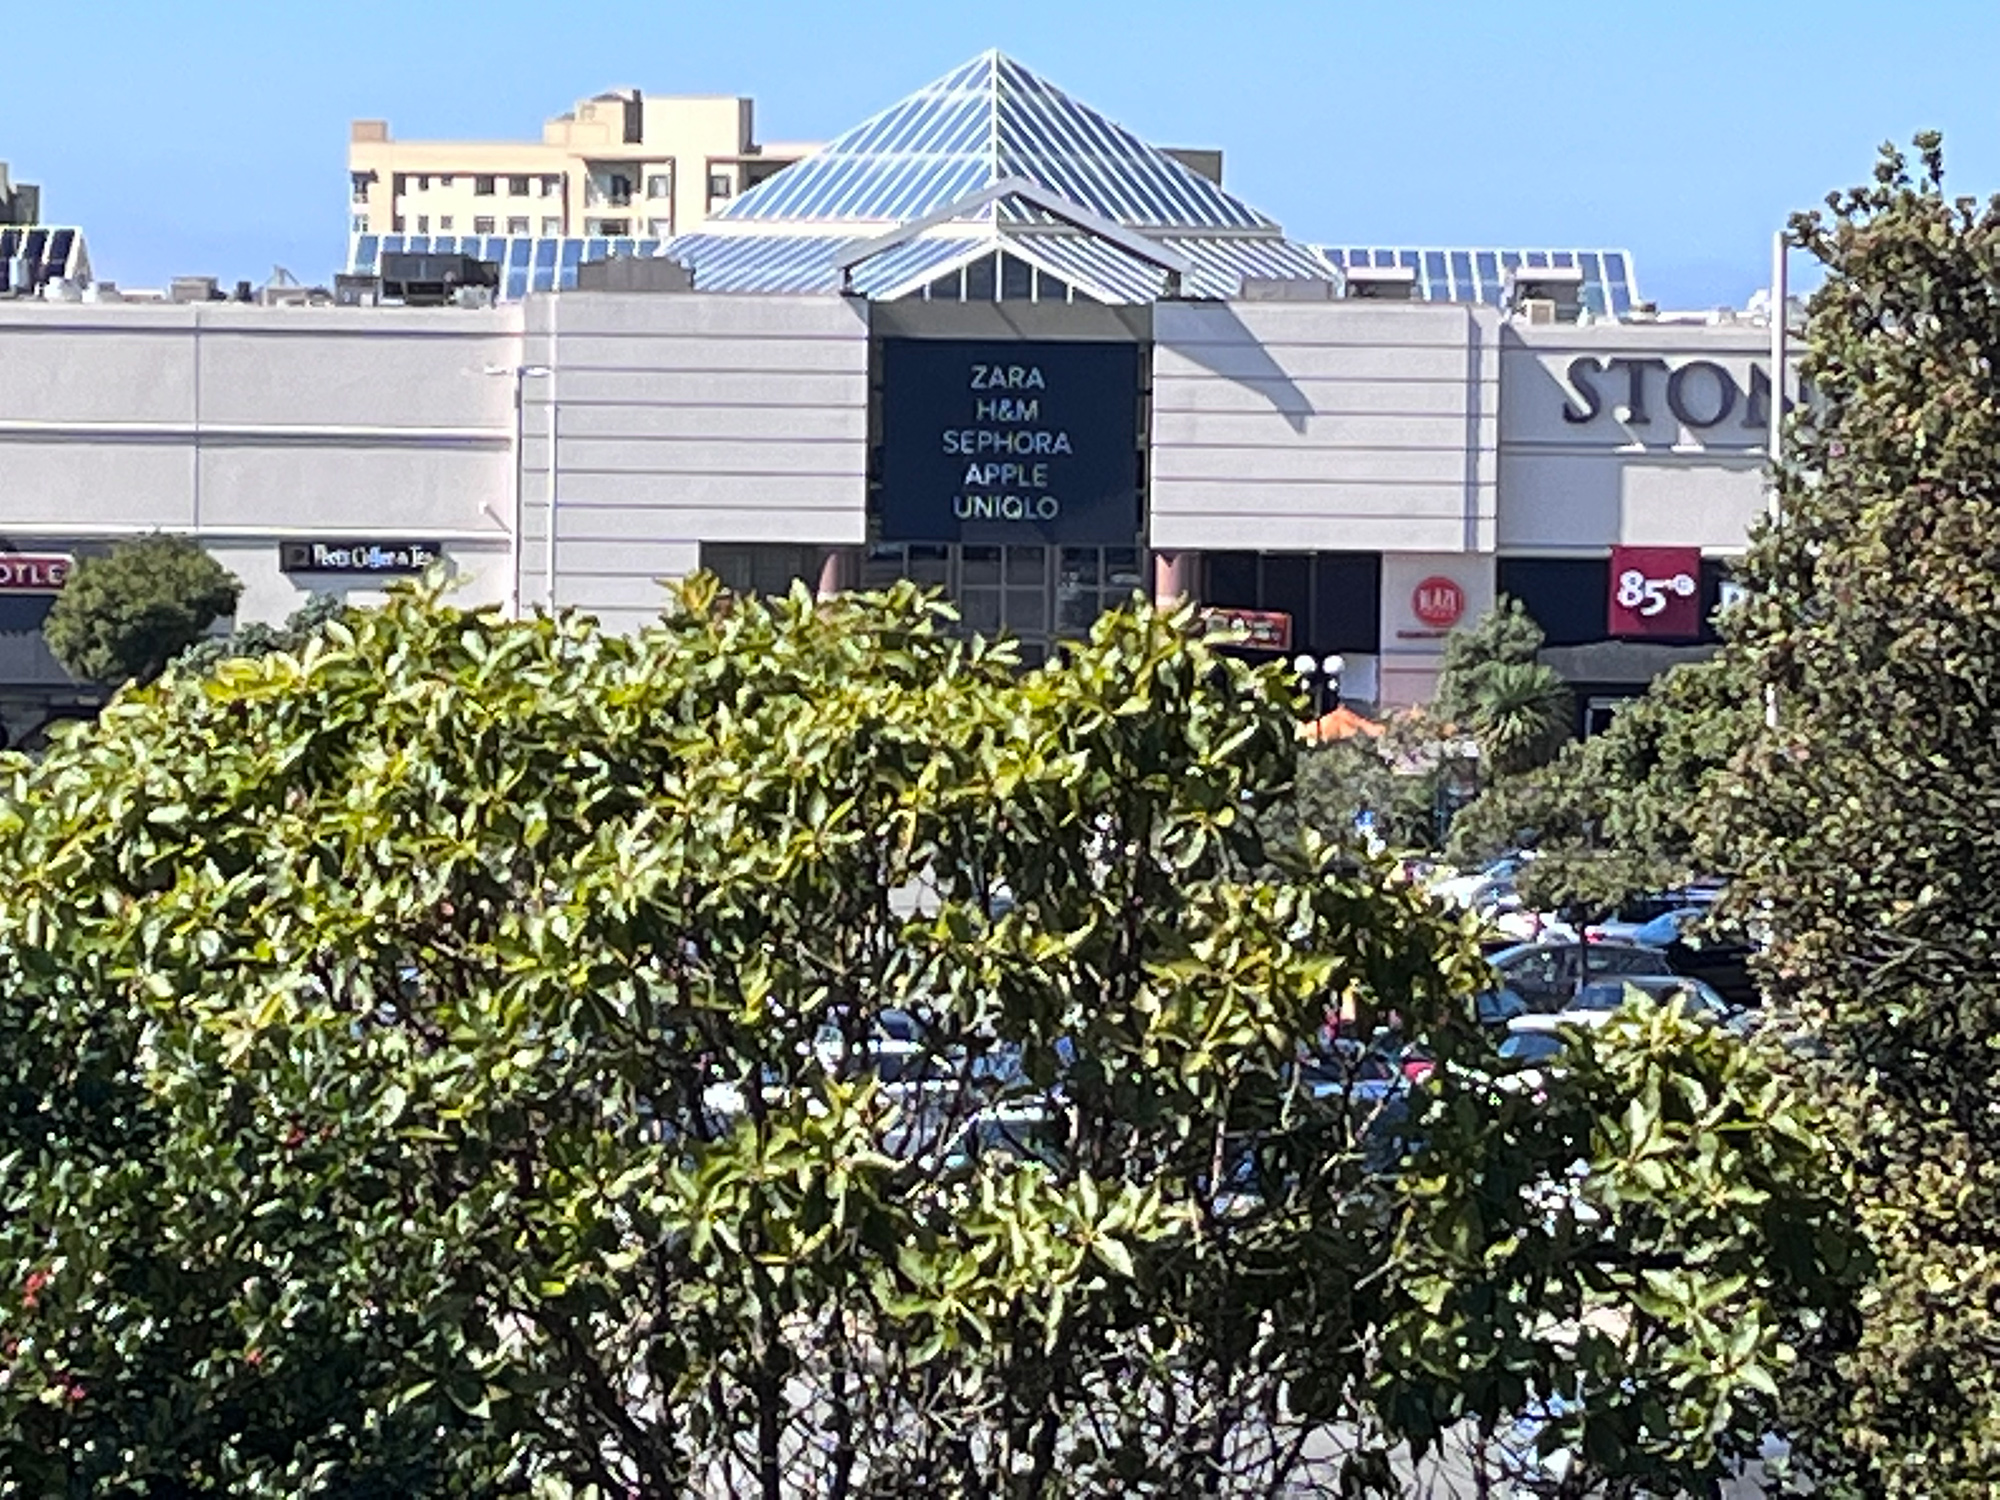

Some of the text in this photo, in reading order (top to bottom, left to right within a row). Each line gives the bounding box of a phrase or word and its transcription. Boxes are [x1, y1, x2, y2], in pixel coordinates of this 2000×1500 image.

[970, 364, 1045, 389] ZARA
[975, 398, 1039, 421] H&M
[942, 431, 1073, 454] SEPHORA
[965, 463, 1048, 487] APPLE
[953, 496, 1060, 519] UNIQLO
